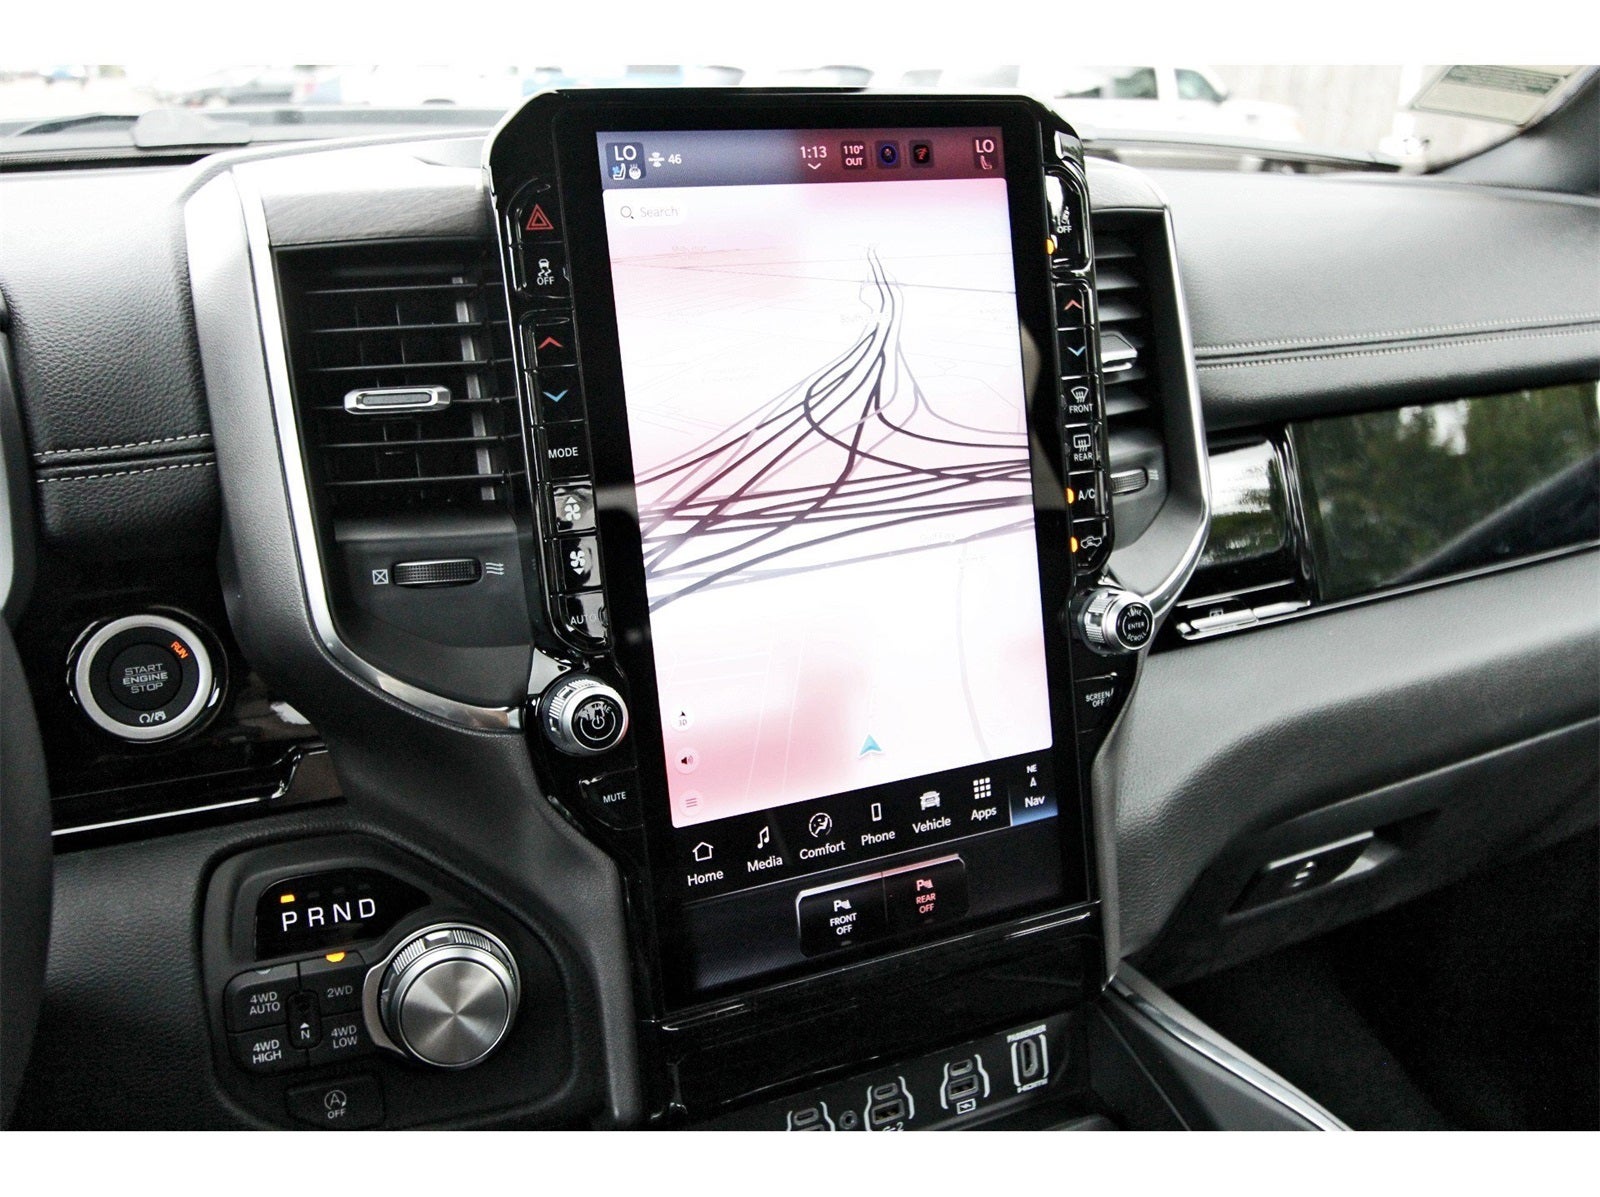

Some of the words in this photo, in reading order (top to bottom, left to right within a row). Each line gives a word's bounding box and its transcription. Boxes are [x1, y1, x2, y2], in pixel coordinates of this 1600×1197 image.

[800, 145, 827, 159] 1:13
[975, 139, 995, 153] LO
[614, 145, 637, 161] LO
[667, 153, 682, 165] 46
[845, 158, 863, 166] OUT
[639, 205, 679, 219] Search
[1056, 225, 1072, 234] OFF
[536, 276, 555, 286] OFF
[1068, 402, 1094, 413] FRONT
[548, 446, 579, 459] MODE
[1073, 451, 1093, 462] REAR
[1078, 488, 1096, 501] A/C
[1128, 621, 1145, 631] ENTER
[171, 641, 189, 659] RUN
[124, 663, 163, 676] START
[122, 671, 168, 685] ENGINE
[131, 682, 164, 694] STOP
[1092, 698, 1105, 708] OFF
[1026, 763, 1038, 774] NE
[602, 791, 627, 803] MUTE
[1024, 795, 1045, 808] Nav
[971, 804, 997, 822] Apps
[912, 815, 952, 835] Vehicle
[860, 828, 896, 847] Phone
[799, 839, 846, 860] Comfort
[746, 853, 783, 874] Media
[687, 868, 724, 887] Home
[915, 892, 936, 905] REAR
[918, 902, 934, 915] OFF
[829, 912, 857, 928] FRONT
[835, 924, 853, 936] OFF
[326, 984, 353, 998] 2WD
[249, 991, 278, 1005] 4WD
[249, 1001, 280, 1016] AUTO
[331, 1024, 357, 1038] 4WD
[253, 1039, 280, 1052] 4WD
[332, 1035, 358, 1049] LOW
[252, 1049, 282, 1065] HIGH
[327, 1107, 347, 1120] OFF
